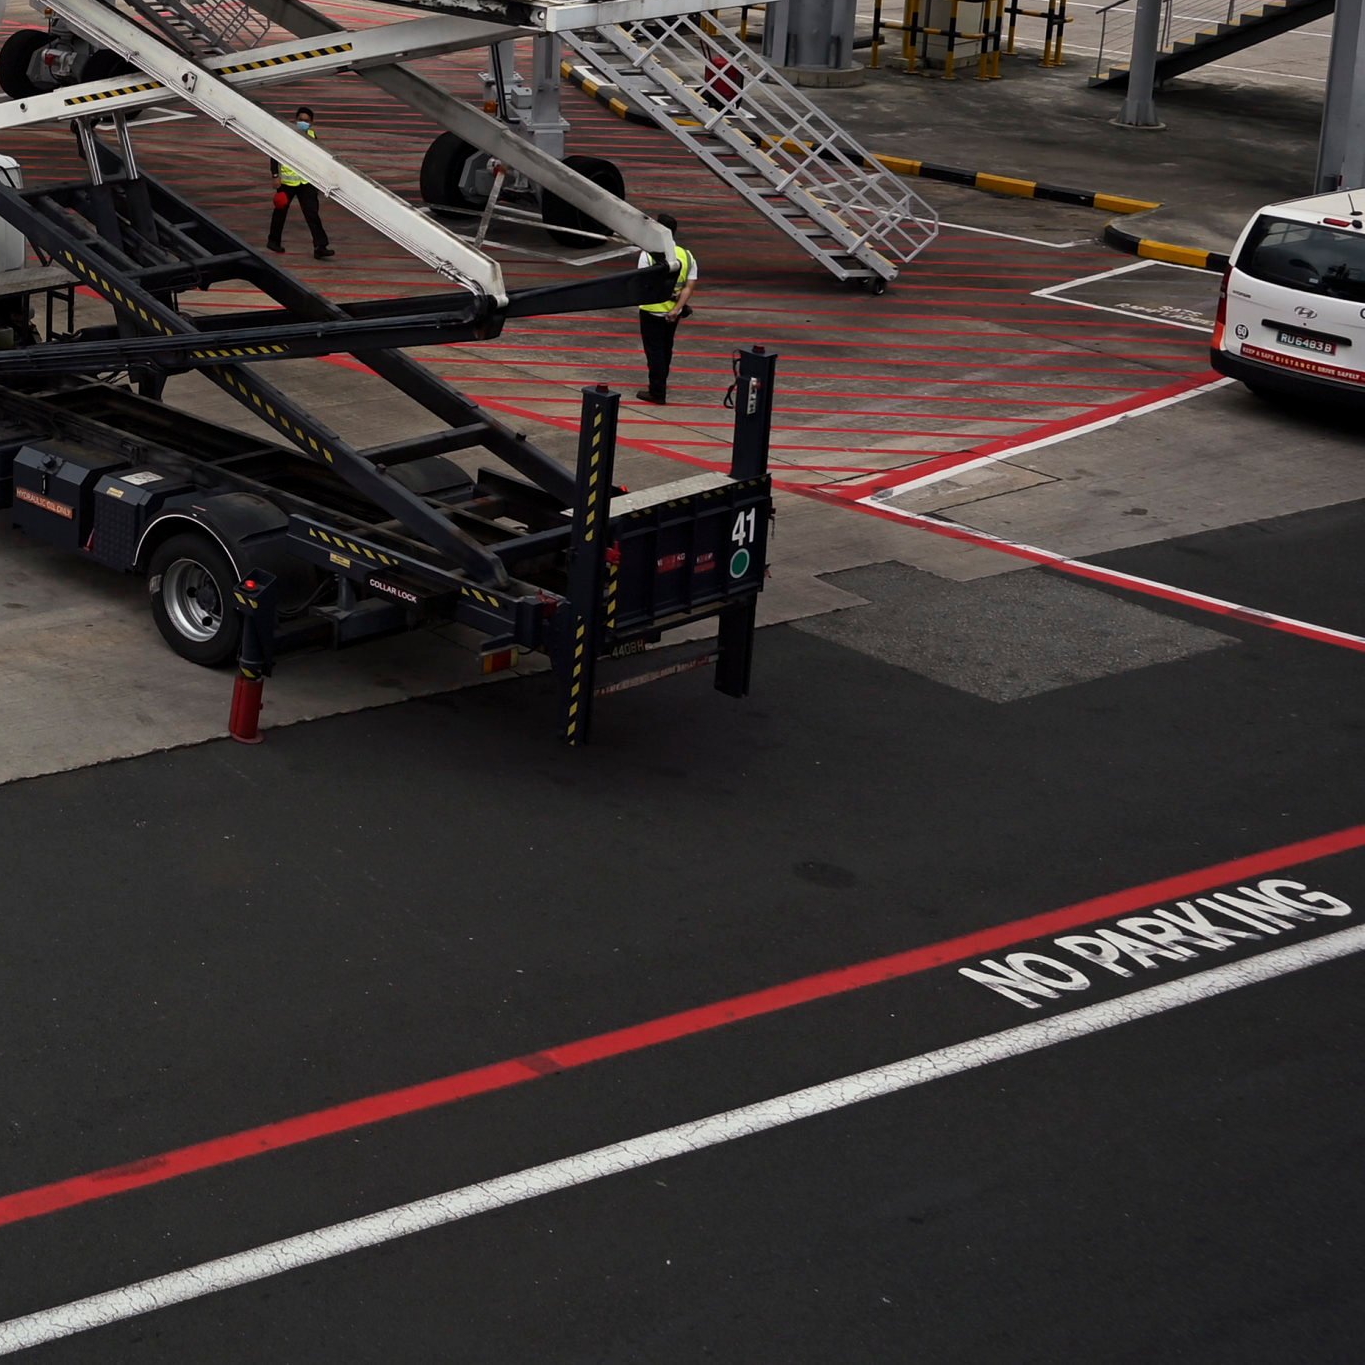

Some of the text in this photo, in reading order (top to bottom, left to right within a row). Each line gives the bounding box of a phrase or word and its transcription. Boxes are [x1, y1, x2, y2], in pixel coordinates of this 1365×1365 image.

[1242, 346, 1254, 356] KEEP
[1261, 351, 1274, 362] SAFE
[1275, 355, 1317, 371] DISTANCE
[1317, 365, 1336, 376] DRIVE
[1337, 369, 1360, 380] SAFELY
[16, 488, 45, 509] HYDRAULIC
[57, 504, 73, 518] ONLY
[731, 507, 755, 546] 41
[369, 578, 417, 604] COLLAR LOCK
[958, 878, 1352, 1009] NO PARKING
